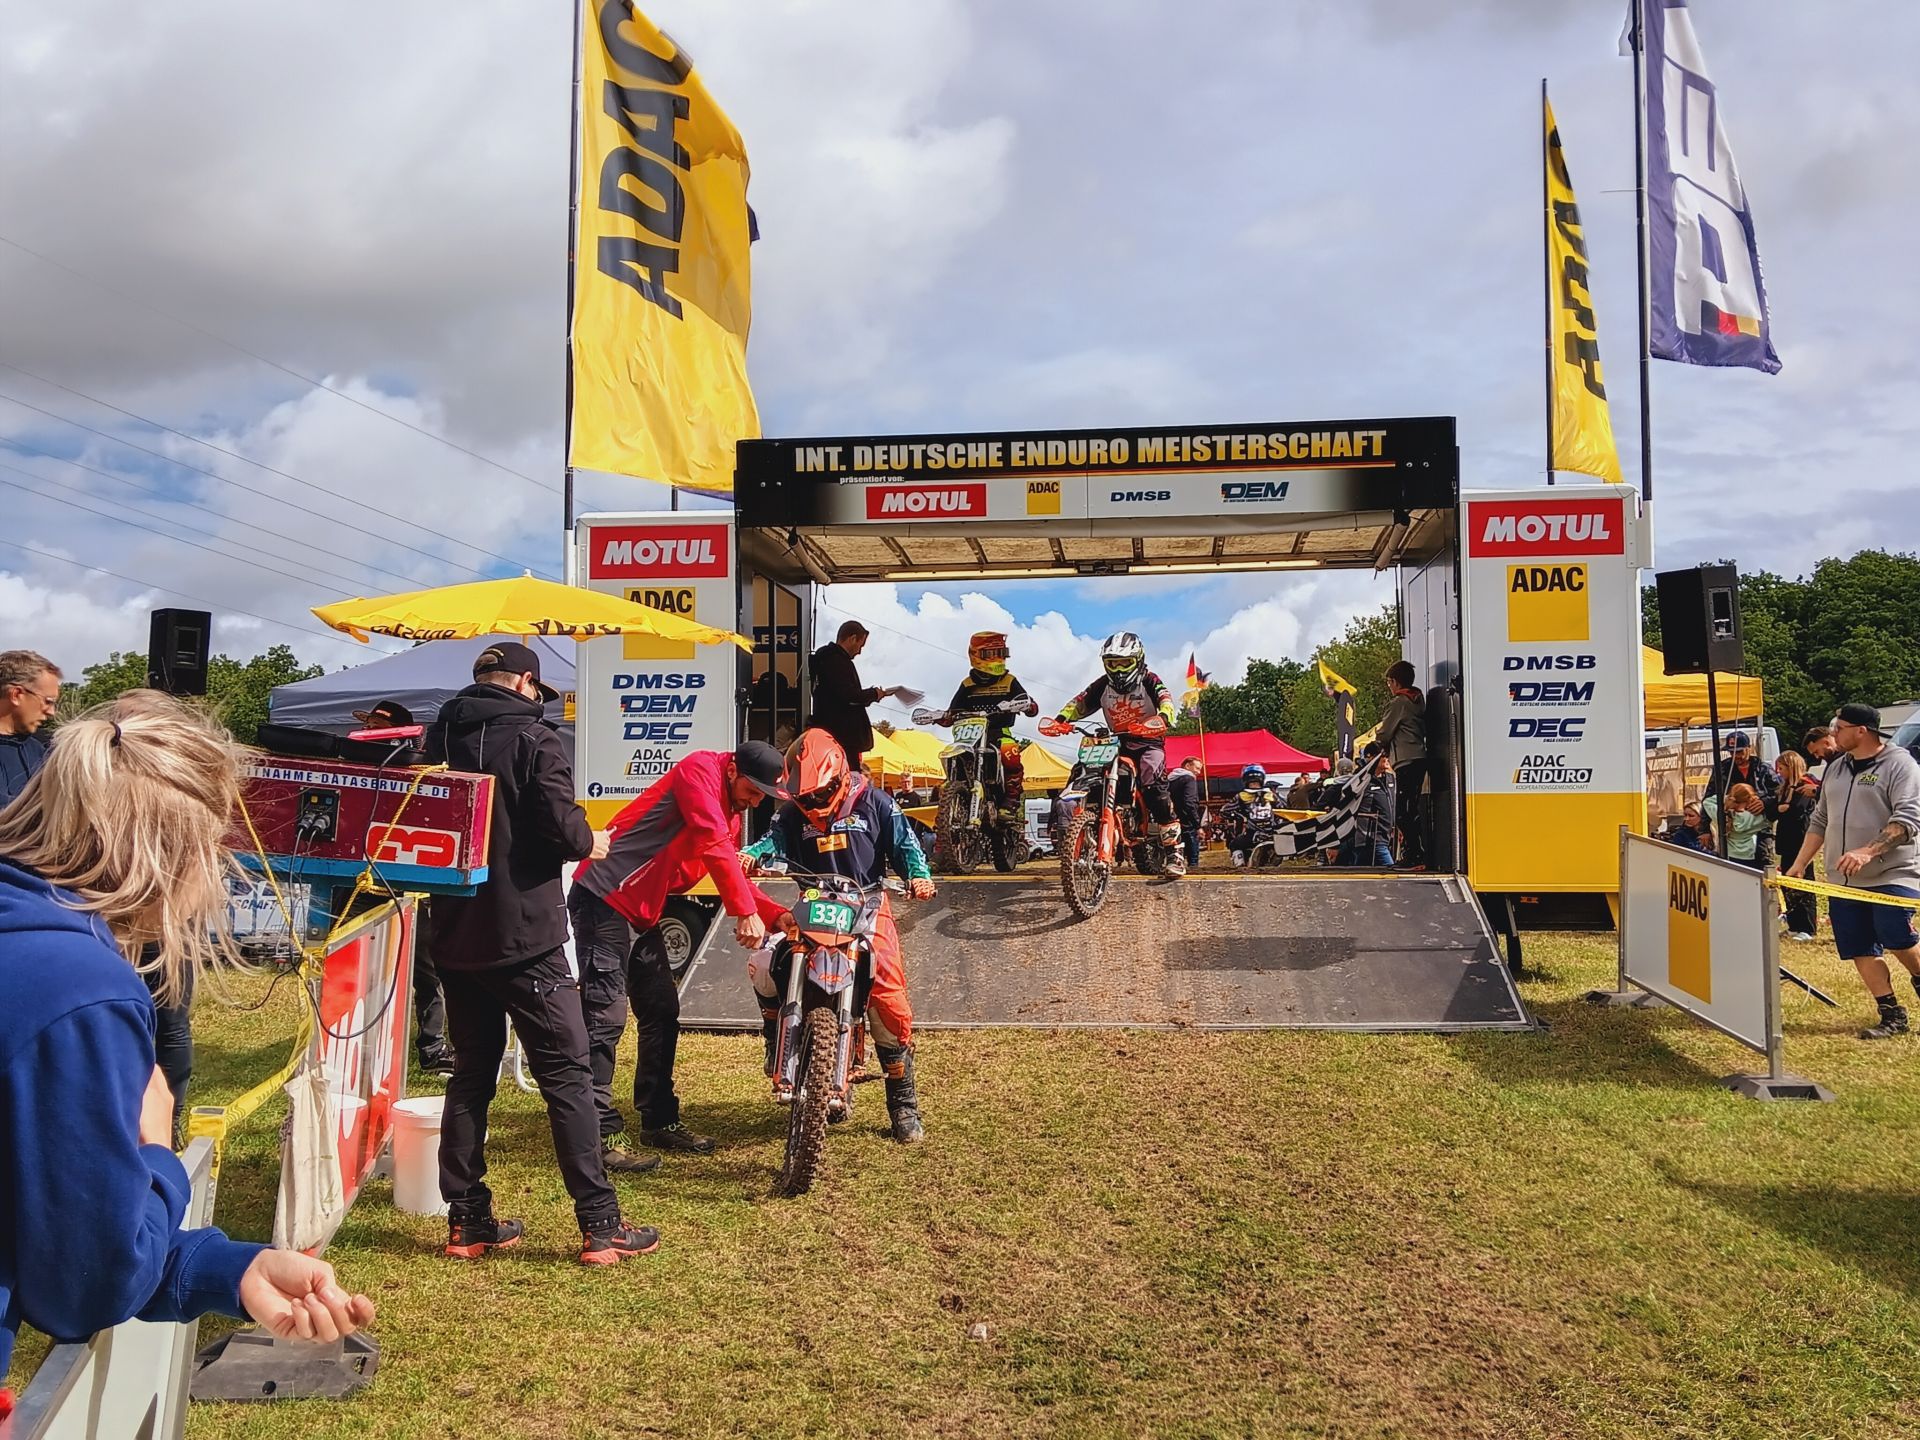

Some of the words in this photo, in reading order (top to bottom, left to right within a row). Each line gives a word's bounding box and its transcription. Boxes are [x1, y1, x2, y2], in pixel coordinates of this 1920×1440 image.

[597, 0, 694, 321] ADAC
[795, 446, 847, 472] INT.
[853, 442, 1003, 471] DEUTSCHE
[1010, 437, 1130, 467] ENDURO
[1137, 430, 1387, 464] MEISTERSCHAFT
[1028, 481, 1059, 494] ADAC
[1110, 490, 1171, 502] DMSB
[1221, 481, 1289, 499] DEM
[881, 491, 971, 512] MOTUL
[1482, 513, 1610, 543] MOTUL
[602, 539, 716, 565] MOTUL
[1511, 567, 1584, 592] ADAC
[629, 590, 693, 614] ADAC
[1503, 655, 1596, 671] DMSB
[612, 673, 706, 690] DMSB
[1508, 681, 1596, 702] DEM
[620, 694, 698, 713] DEM
[623, 722, 693, 740] DEC
[954, 724, 984, 740] 368
[1508, 718, 1586, 738] DEC
[632, 748, 672, 760] ADAC
[1520, 754, 1566, 767] ADAC
[1518, 769, 1590, 782] ENDURO
[1669, 871, 1708, 921] ADAC
[812, 903, 848, 929] 334
